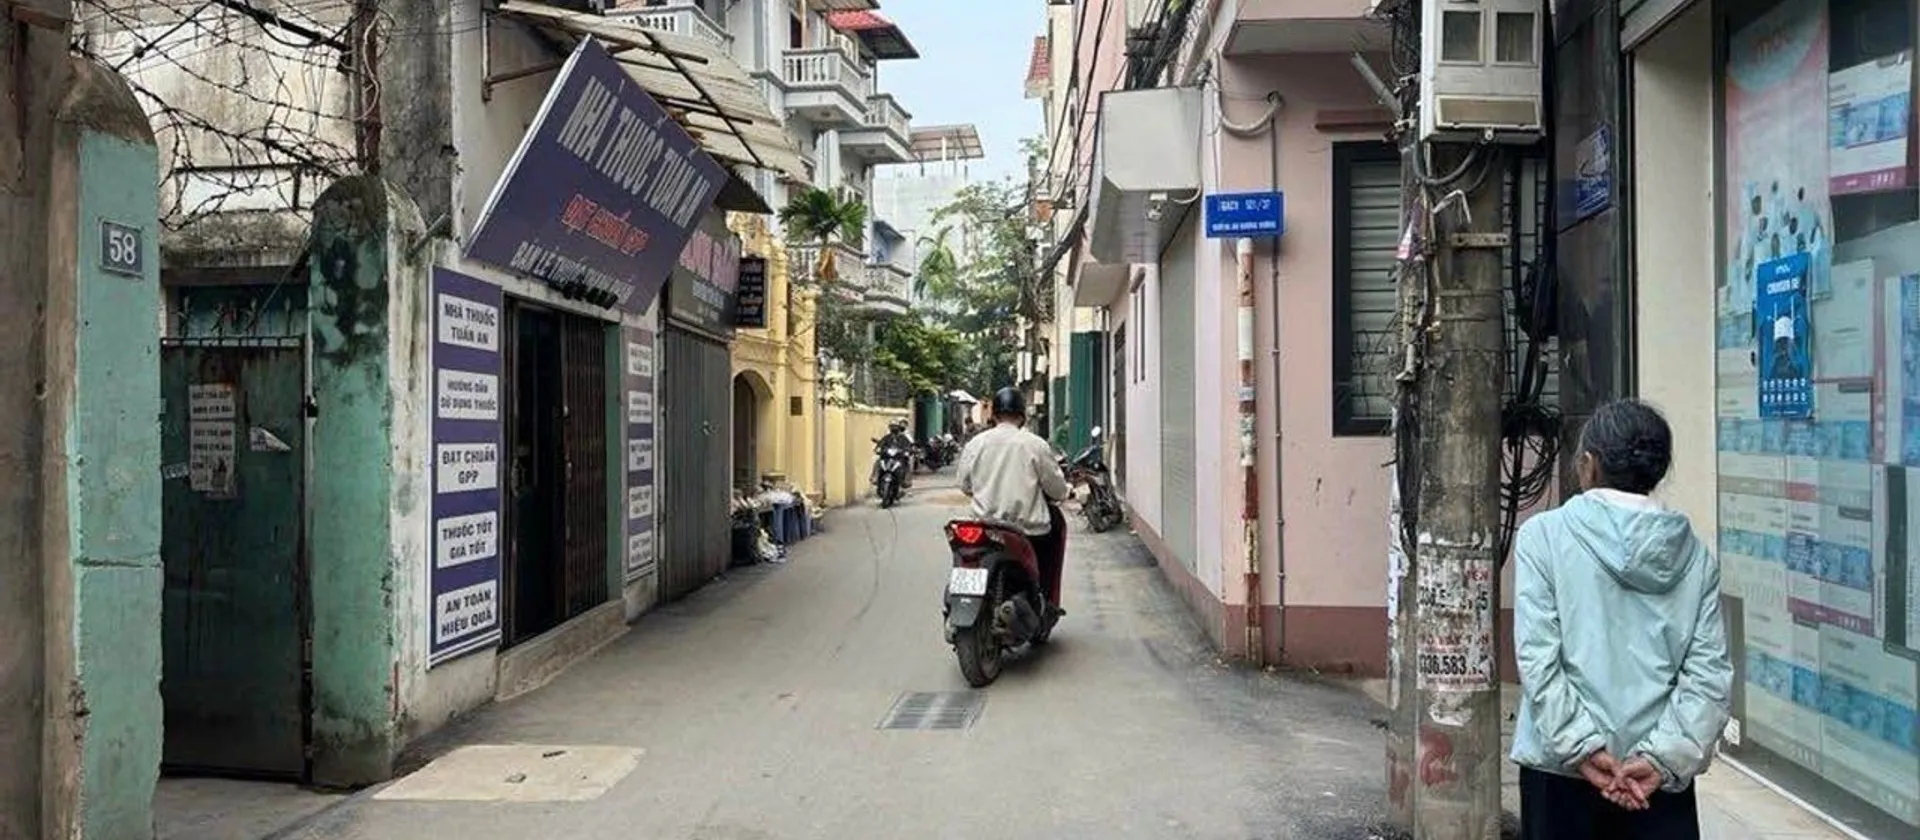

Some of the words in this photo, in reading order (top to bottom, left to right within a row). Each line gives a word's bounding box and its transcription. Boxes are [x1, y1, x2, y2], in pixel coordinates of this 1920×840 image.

[556, 75, 625, 163] NHÀ
[596, 105, 668, 196] THUỐC
[644, 145, 701, 223] TUẤN
[671, 174, 711, 229] AN
[109, 230, 136, 265] 58
[510, 239, 542, 272] BÁN
[445, 303, 463, 320] NHÀ
[466, 306, 495, 327] THUỐC
[451, 325, 474, 342] TUẤN
[477, 331, 489, 344] AN
[442, 450, 462, 466] ĐẠT
[464, 446, 495, 464] CHUẨN
[458, 471, 479, 484] GPP
[442, 523, 474, 540] THUỐC
[476, 520, 492, 536] TỐT
[450, 545, 466, 559] GIÁ
[469, 541, 487, 556] TỐT
[445, 598, 462, 614] AN
[464, 591, 491, 608] TOÀN
[441, 616, 468, 637] HIỆU
[471, 607, 493, 627] QUẢ
